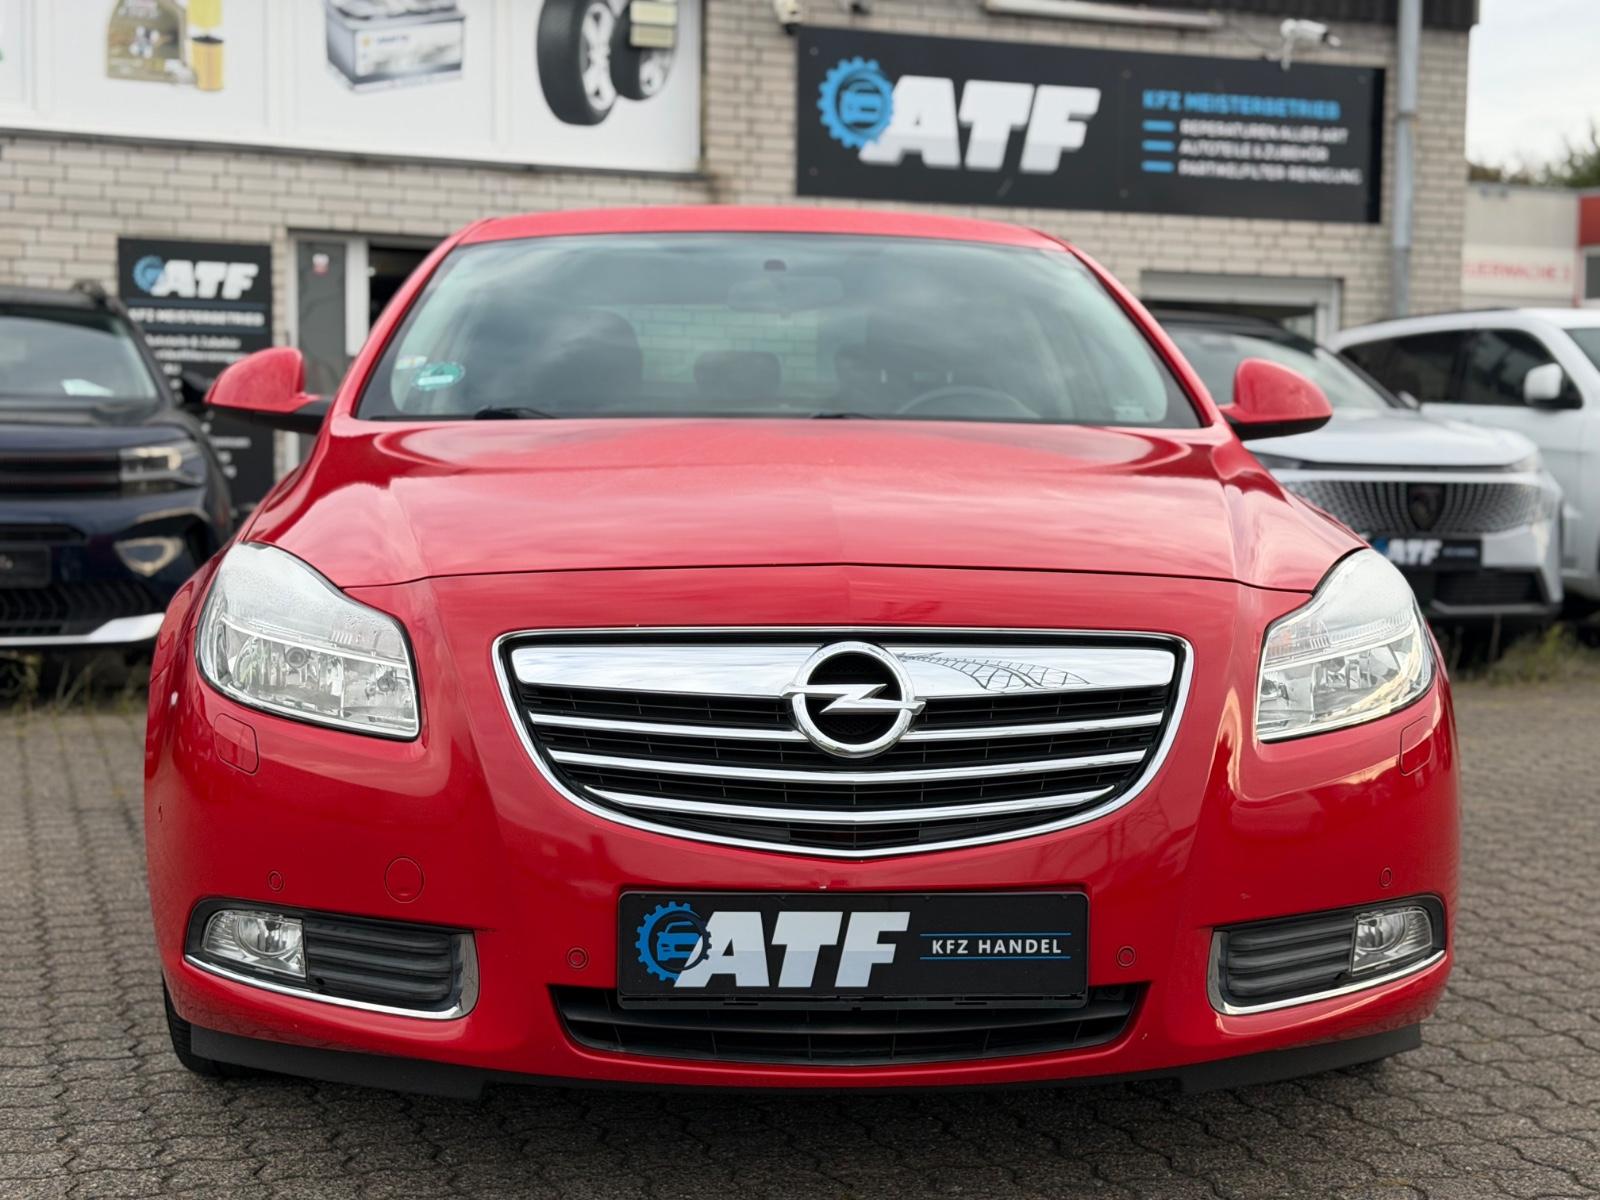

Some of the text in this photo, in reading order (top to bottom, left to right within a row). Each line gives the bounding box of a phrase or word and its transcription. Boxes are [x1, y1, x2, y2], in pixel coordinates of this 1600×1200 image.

[1142, 90, 1341, 120] KFZ MEISTERBETRIEB
[858, 74, 1101, 174] ATF
[1178, 139, 1250, 158] AUTOTEILE
[1287, 166, 1362, 184] REINIGUNG
[151, 259, 259, 299] ATF
[1388, 538, 1442, 566] ATF
[674, 911, 1062, 988] ATF KFZ HANDEL
